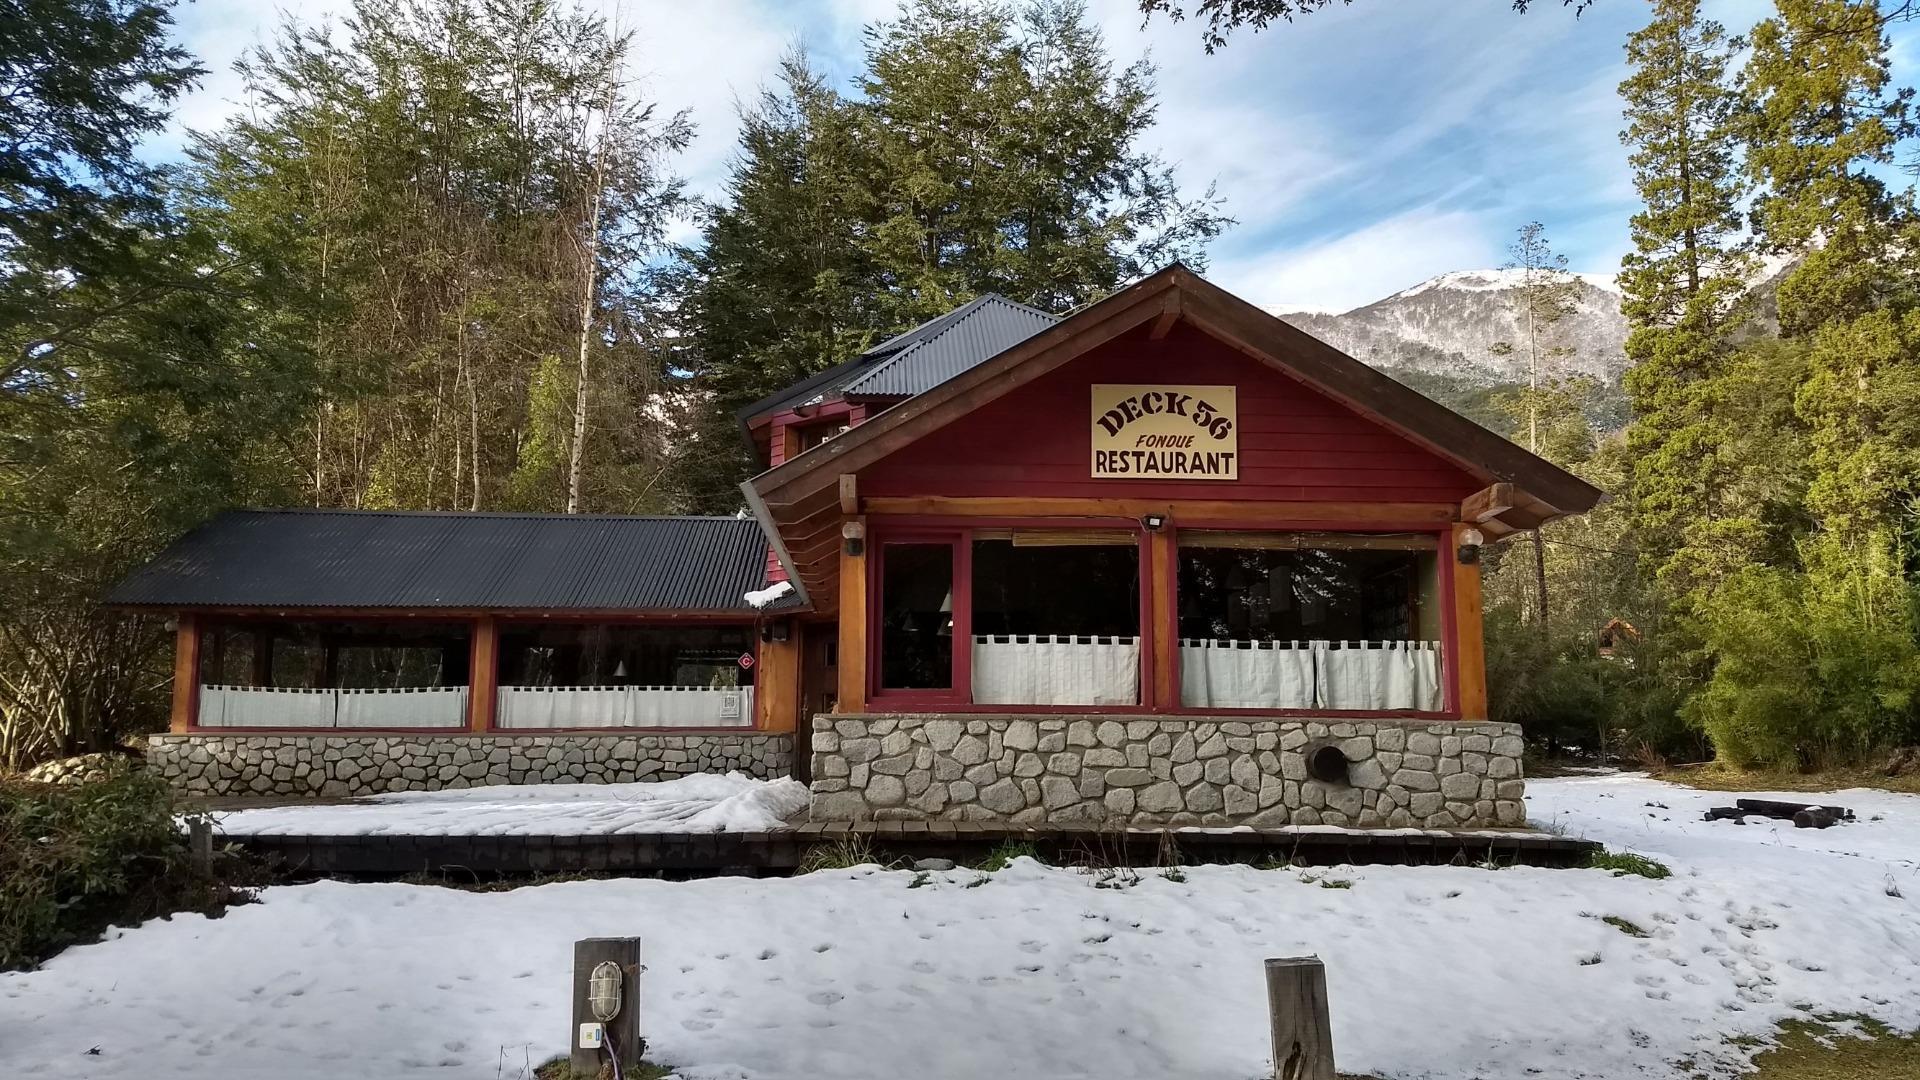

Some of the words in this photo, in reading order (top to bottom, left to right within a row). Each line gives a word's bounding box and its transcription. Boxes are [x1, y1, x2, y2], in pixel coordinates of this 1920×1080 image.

[1096, 392, 1192, 437] DECK
[1192, 400, 1232, 440] 56
[1135, 434, 1195, 448] FONDUE
[1096, 450, 1234, 474] RESTAURANT
